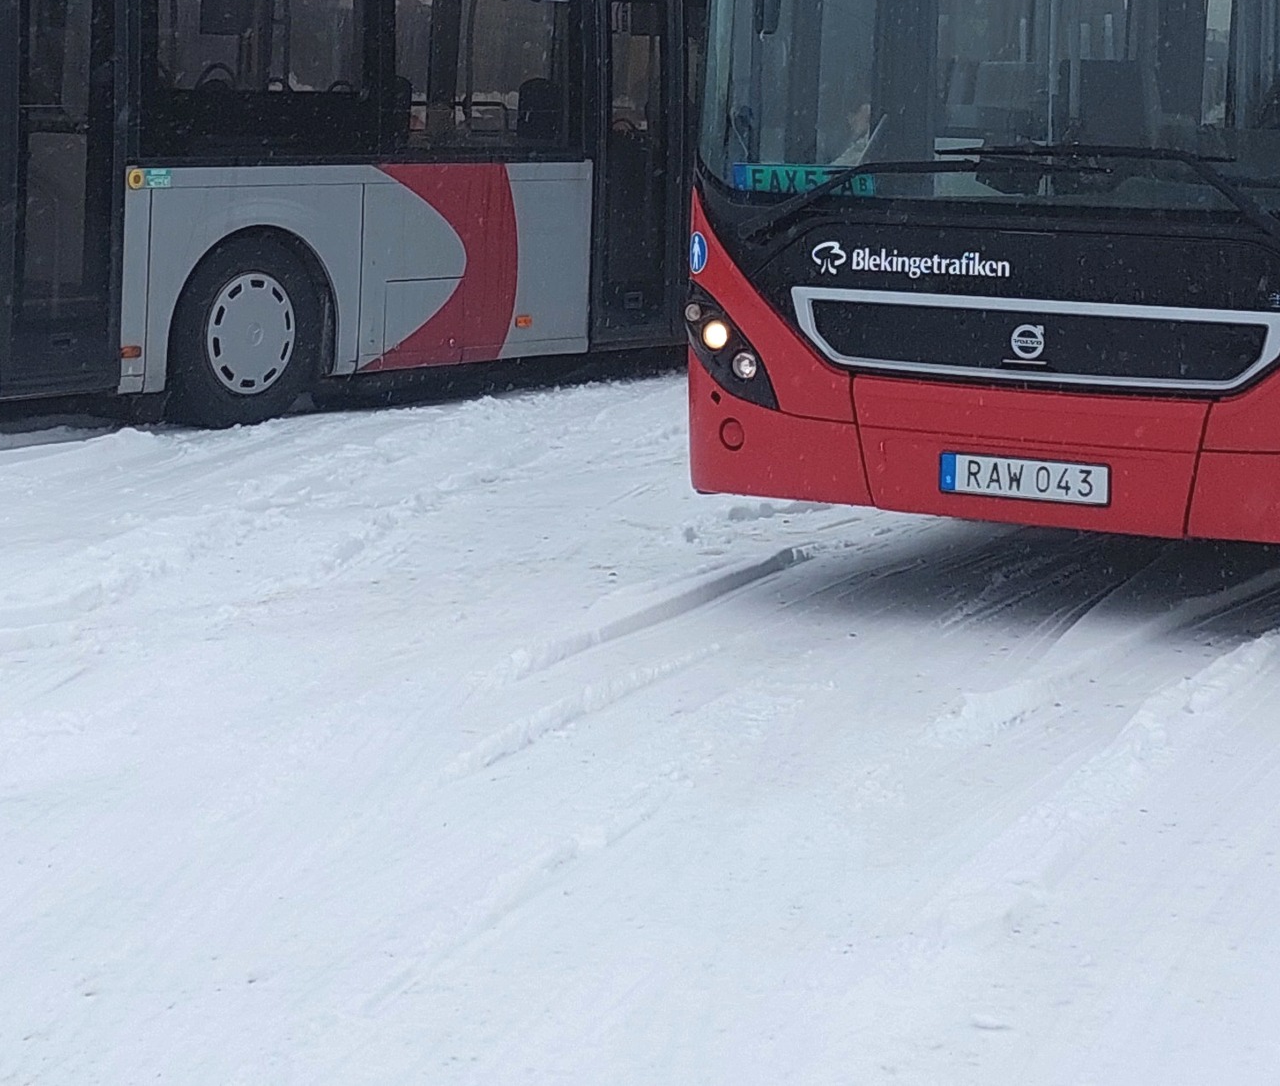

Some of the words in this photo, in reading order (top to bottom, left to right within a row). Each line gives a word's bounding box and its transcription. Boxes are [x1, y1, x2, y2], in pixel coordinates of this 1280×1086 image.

[852, 248, 1010, 278] Blekingetrafiken
[967, 460, 1024, 492] RAW
[1036, 466, 1093, 497] 043
